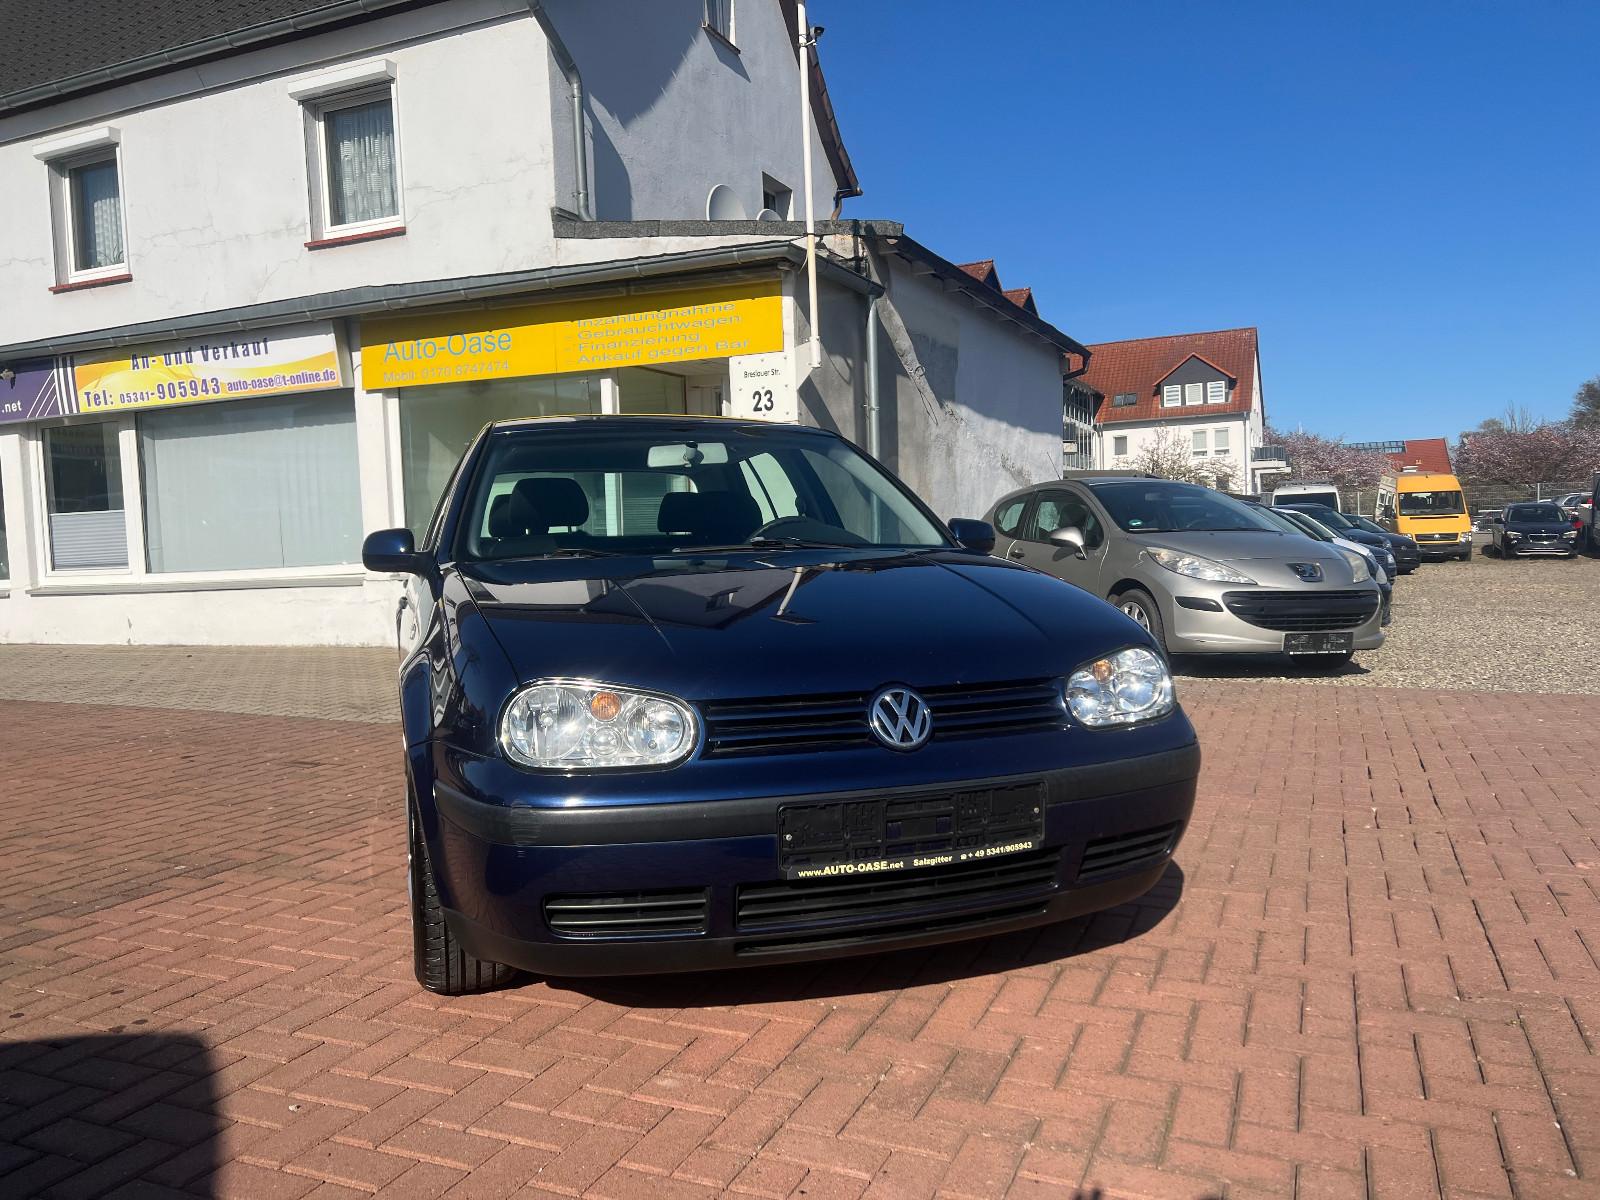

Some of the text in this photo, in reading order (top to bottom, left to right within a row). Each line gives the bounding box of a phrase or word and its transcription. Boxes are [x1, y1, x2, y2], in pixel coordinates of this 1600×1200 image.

[577, 315, 742, 340] Gebrauchtwagen
[131, 338, 269, 370] An- und Verkauf
[383, 331, 512, 363] Auto-Oase
[577, 338, 749, 364] Ankauf gegen Bar
[578, 332, 700, 352] Finanzierung
[84, 368, 337, 407] Tel: 05341-905943 auto-oase@t-online.de
[752, 389, 774, 412] 23
[798, 861, 904, 878] www.AUTO-OASE.net
[913, 855, 953, 867] Salzgitter
